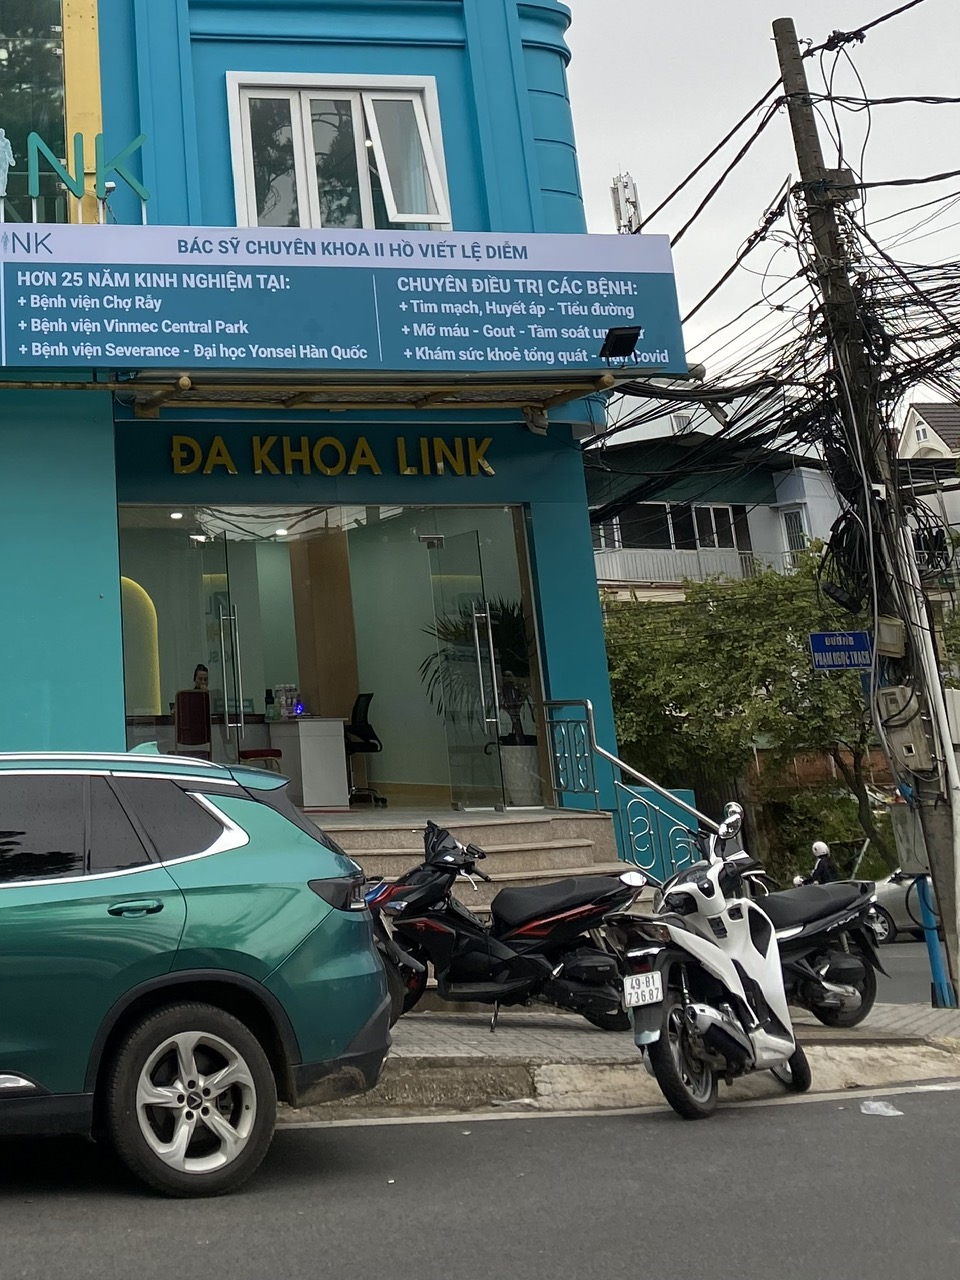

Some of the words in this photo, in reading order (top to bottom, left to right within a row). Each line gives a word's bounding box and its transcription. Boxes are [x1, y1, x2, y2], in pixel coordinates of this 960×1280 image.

[178, 236, 213, 254] BÁC
[219, 237, 240, 254] SỸ
[246, 238, 316, 256] CHUYÊN
[321, 241, 370, 257] KHOA
[375, 243, 384, 257] II
[390, 239, 414, 257] HỒ
[418, 240, 456, 258] VIẾT
[462, 242, 482, 261] LỆ
[486, 241, 528, 259] DIỄM
[17, 271, 57, 286] HƠN
[61, 272, 83, 287] 25
[88, 269, 130, 287] NĂM
[134, 272, 177, 288] KINH
[183, 271, 252, 291] NGHIỆM
[256, 274, 290, 292] TẠI:
[397, 274, 467, 292] CHUYÊN
[471, 274, 510, 293] ĐIỀU
[514, 279, 543, 297] TRỊ
[547, 277, 582, 295] CÁC
[587, 277, 638, 297] BỆNH:
[30, 294, 66, 310] Bệnh
[70, 295, 99, 311] viện
[103, 295, 132, 311] Chợ
[410, 300, 438, 313] Tim
[441, 301, 483, 316] mạch,
[486, 300, 526, 317] Huyết
[529, 302, 545, 317] áp
[557, 301, 588, 316] Tiểu
[591, 302, 634, 319] đường
[31, 318, 67, 334] Bệnh
[71, 319, 100, 335] viện
[103, 319, 158, 333] Vinmec
[162, 320, 212, 334] Central
[215, 320, 249, 334] Park
[413, 322, 436, 337] Mỡ
[439, 322, 469, 337] máu
[483, 324, 516, 338] Gout
[528, 323, 557, 338] Tầm
[561, 325, 590, 339] soát
[32, 342, 68, 359] Bệnh
[72, 343, 101, 359] viện
[105, 344, 179, 357] Severance
[194, 344, 216, 360] Đại
[219, 344, 246, 360] học
[249, 344, 296, 359] Yonsei
[299, 345, 328, 359] Hàn
[331, 345, 368, 360] Quốc
[415, 347, 455, 361] Khám
[459, 347, 484, 361] sức
[488, 347, 521, 362] khoẻ
[524, 347, 554, 364] tổng
[558, 349, 588, 365] quát
[171, 435, 238, 474] ĐA
[252, 436, 382, 476] KHOA
[397, 437, 496, 476] LINK
